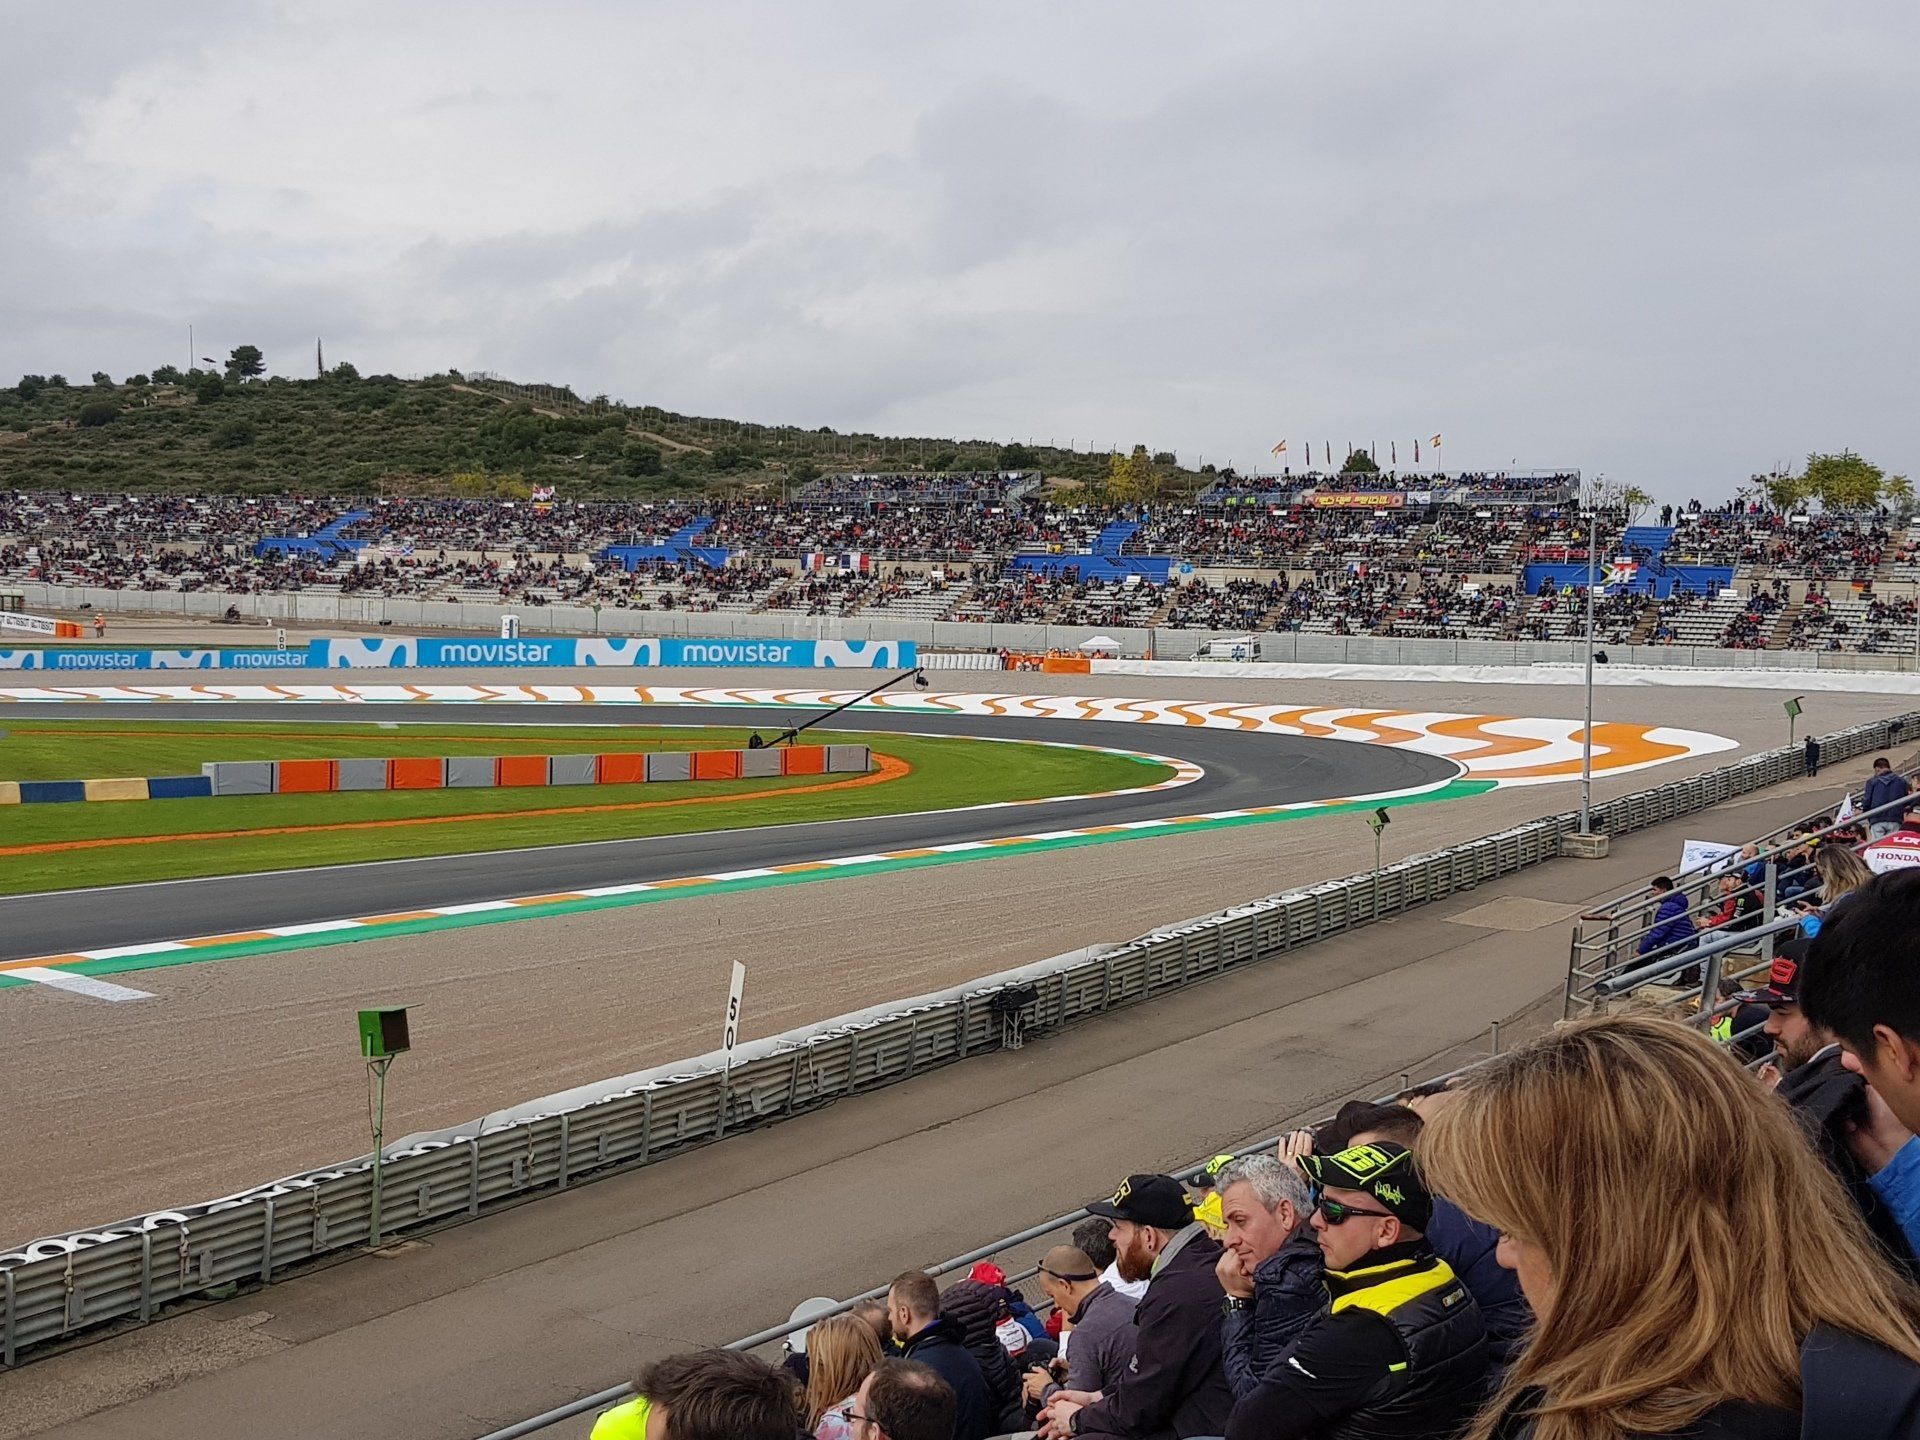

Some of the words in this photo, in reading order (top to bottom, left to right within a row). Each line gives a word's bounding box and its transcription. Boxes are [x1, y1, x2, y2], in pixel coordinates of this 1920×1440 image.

[59, 652, 139, 667] movistar
[233, 652, 309, 666] movistar
[440, 641, 553, 663] movistar
[683, 643, 792, 663] movistar
[1876, 853, 1920, 863] HONDA
[726, 996, 737, 1050] 50
